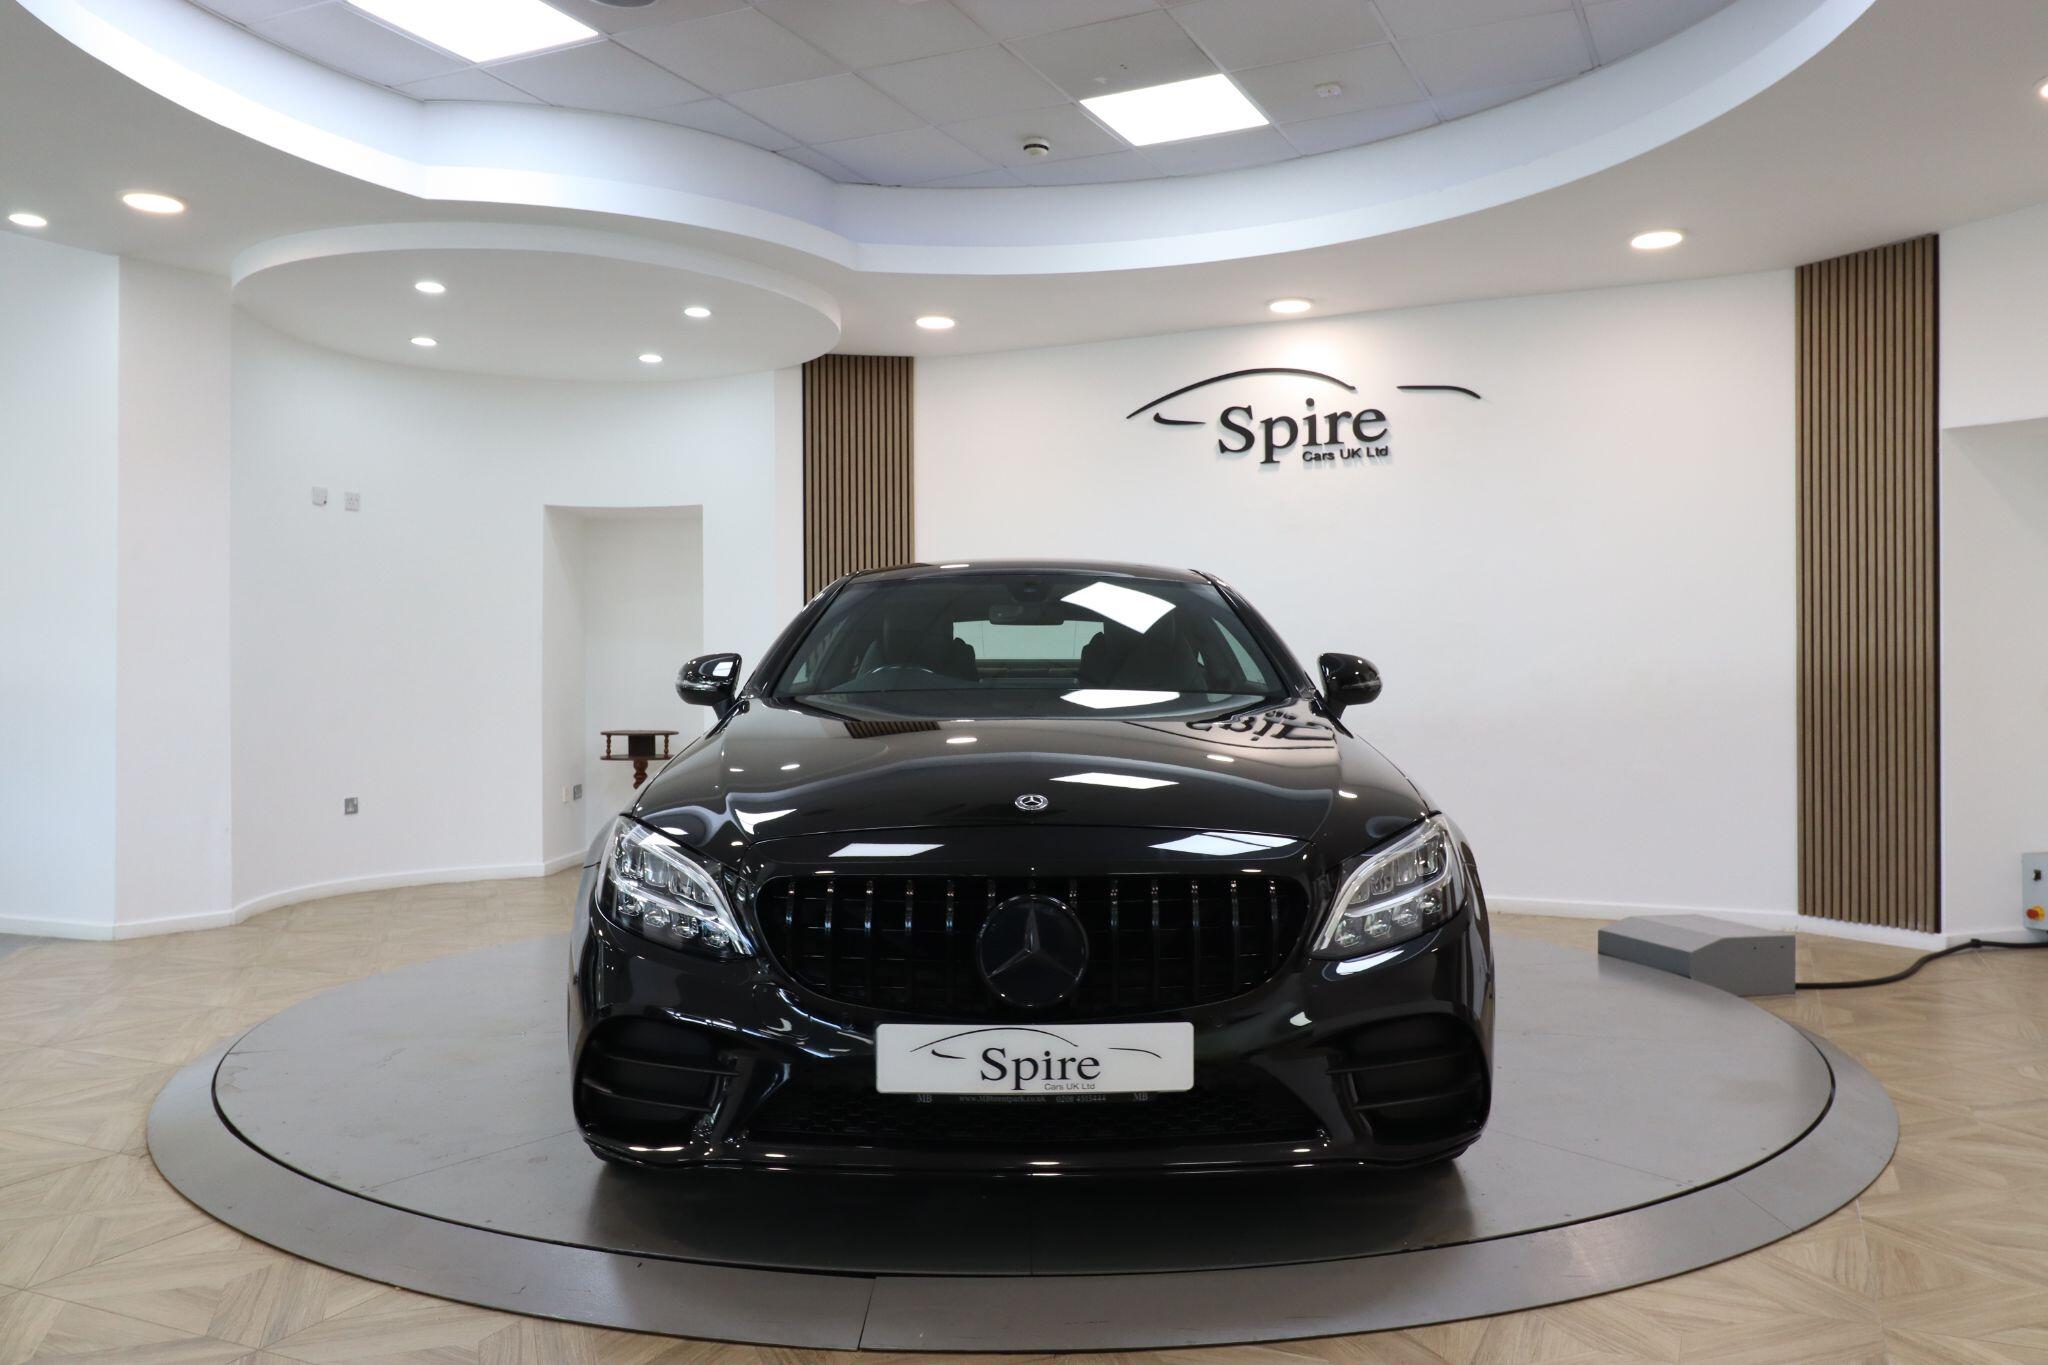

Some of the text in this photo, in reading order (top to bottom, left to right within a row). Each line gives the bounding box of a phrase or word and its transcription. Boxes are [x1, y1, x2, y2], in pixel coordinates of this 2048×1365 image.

[1218, 398, 1388, 464] Spire
[1302, 445, 1389, 462] Cars UK Ltd
[980, 1047, 1101, 1091] Spire
[1044, 1083, 1064, 1091] Cars
